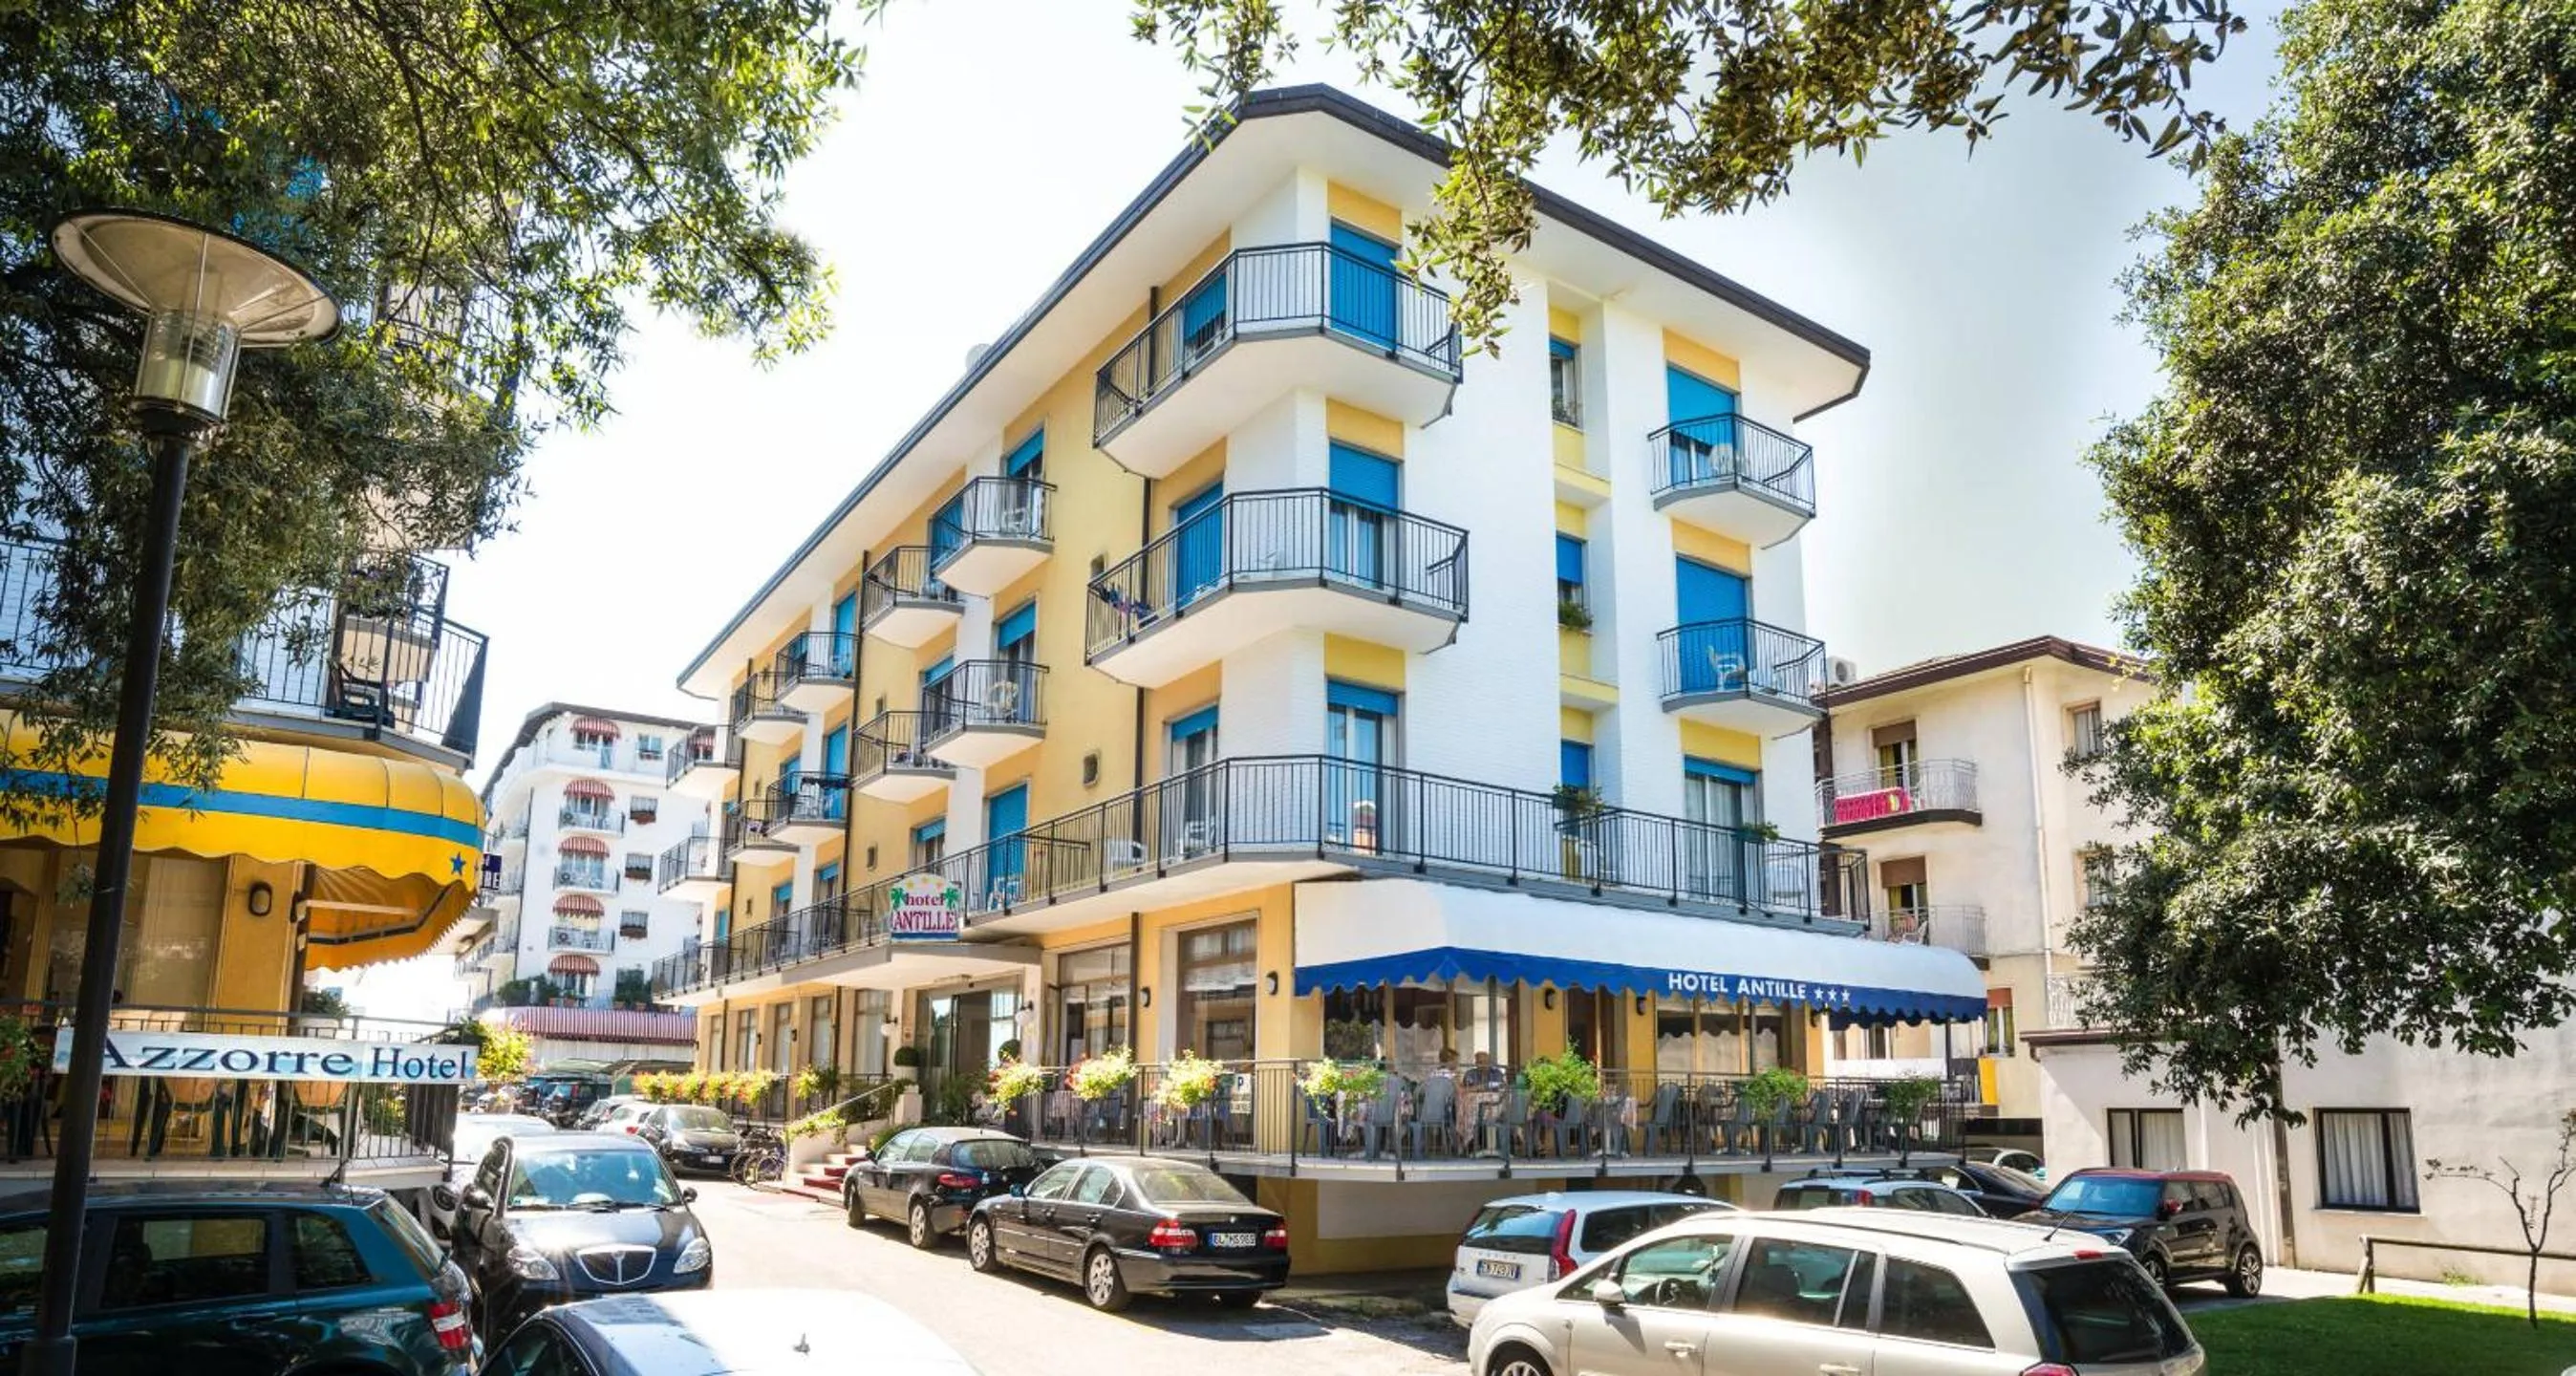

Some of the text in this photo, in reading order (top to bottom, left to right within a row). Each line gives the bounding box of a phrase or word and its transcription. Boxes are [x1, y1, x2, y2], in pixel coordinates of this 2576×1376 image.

[905, 892, 944, 906] hotel
[893, 911, 956, 931] ANTILLE
[1667, 972, 1807, 1000] HOTEL ANTILLE
[370, 1046, 467, 1080] Hotel
